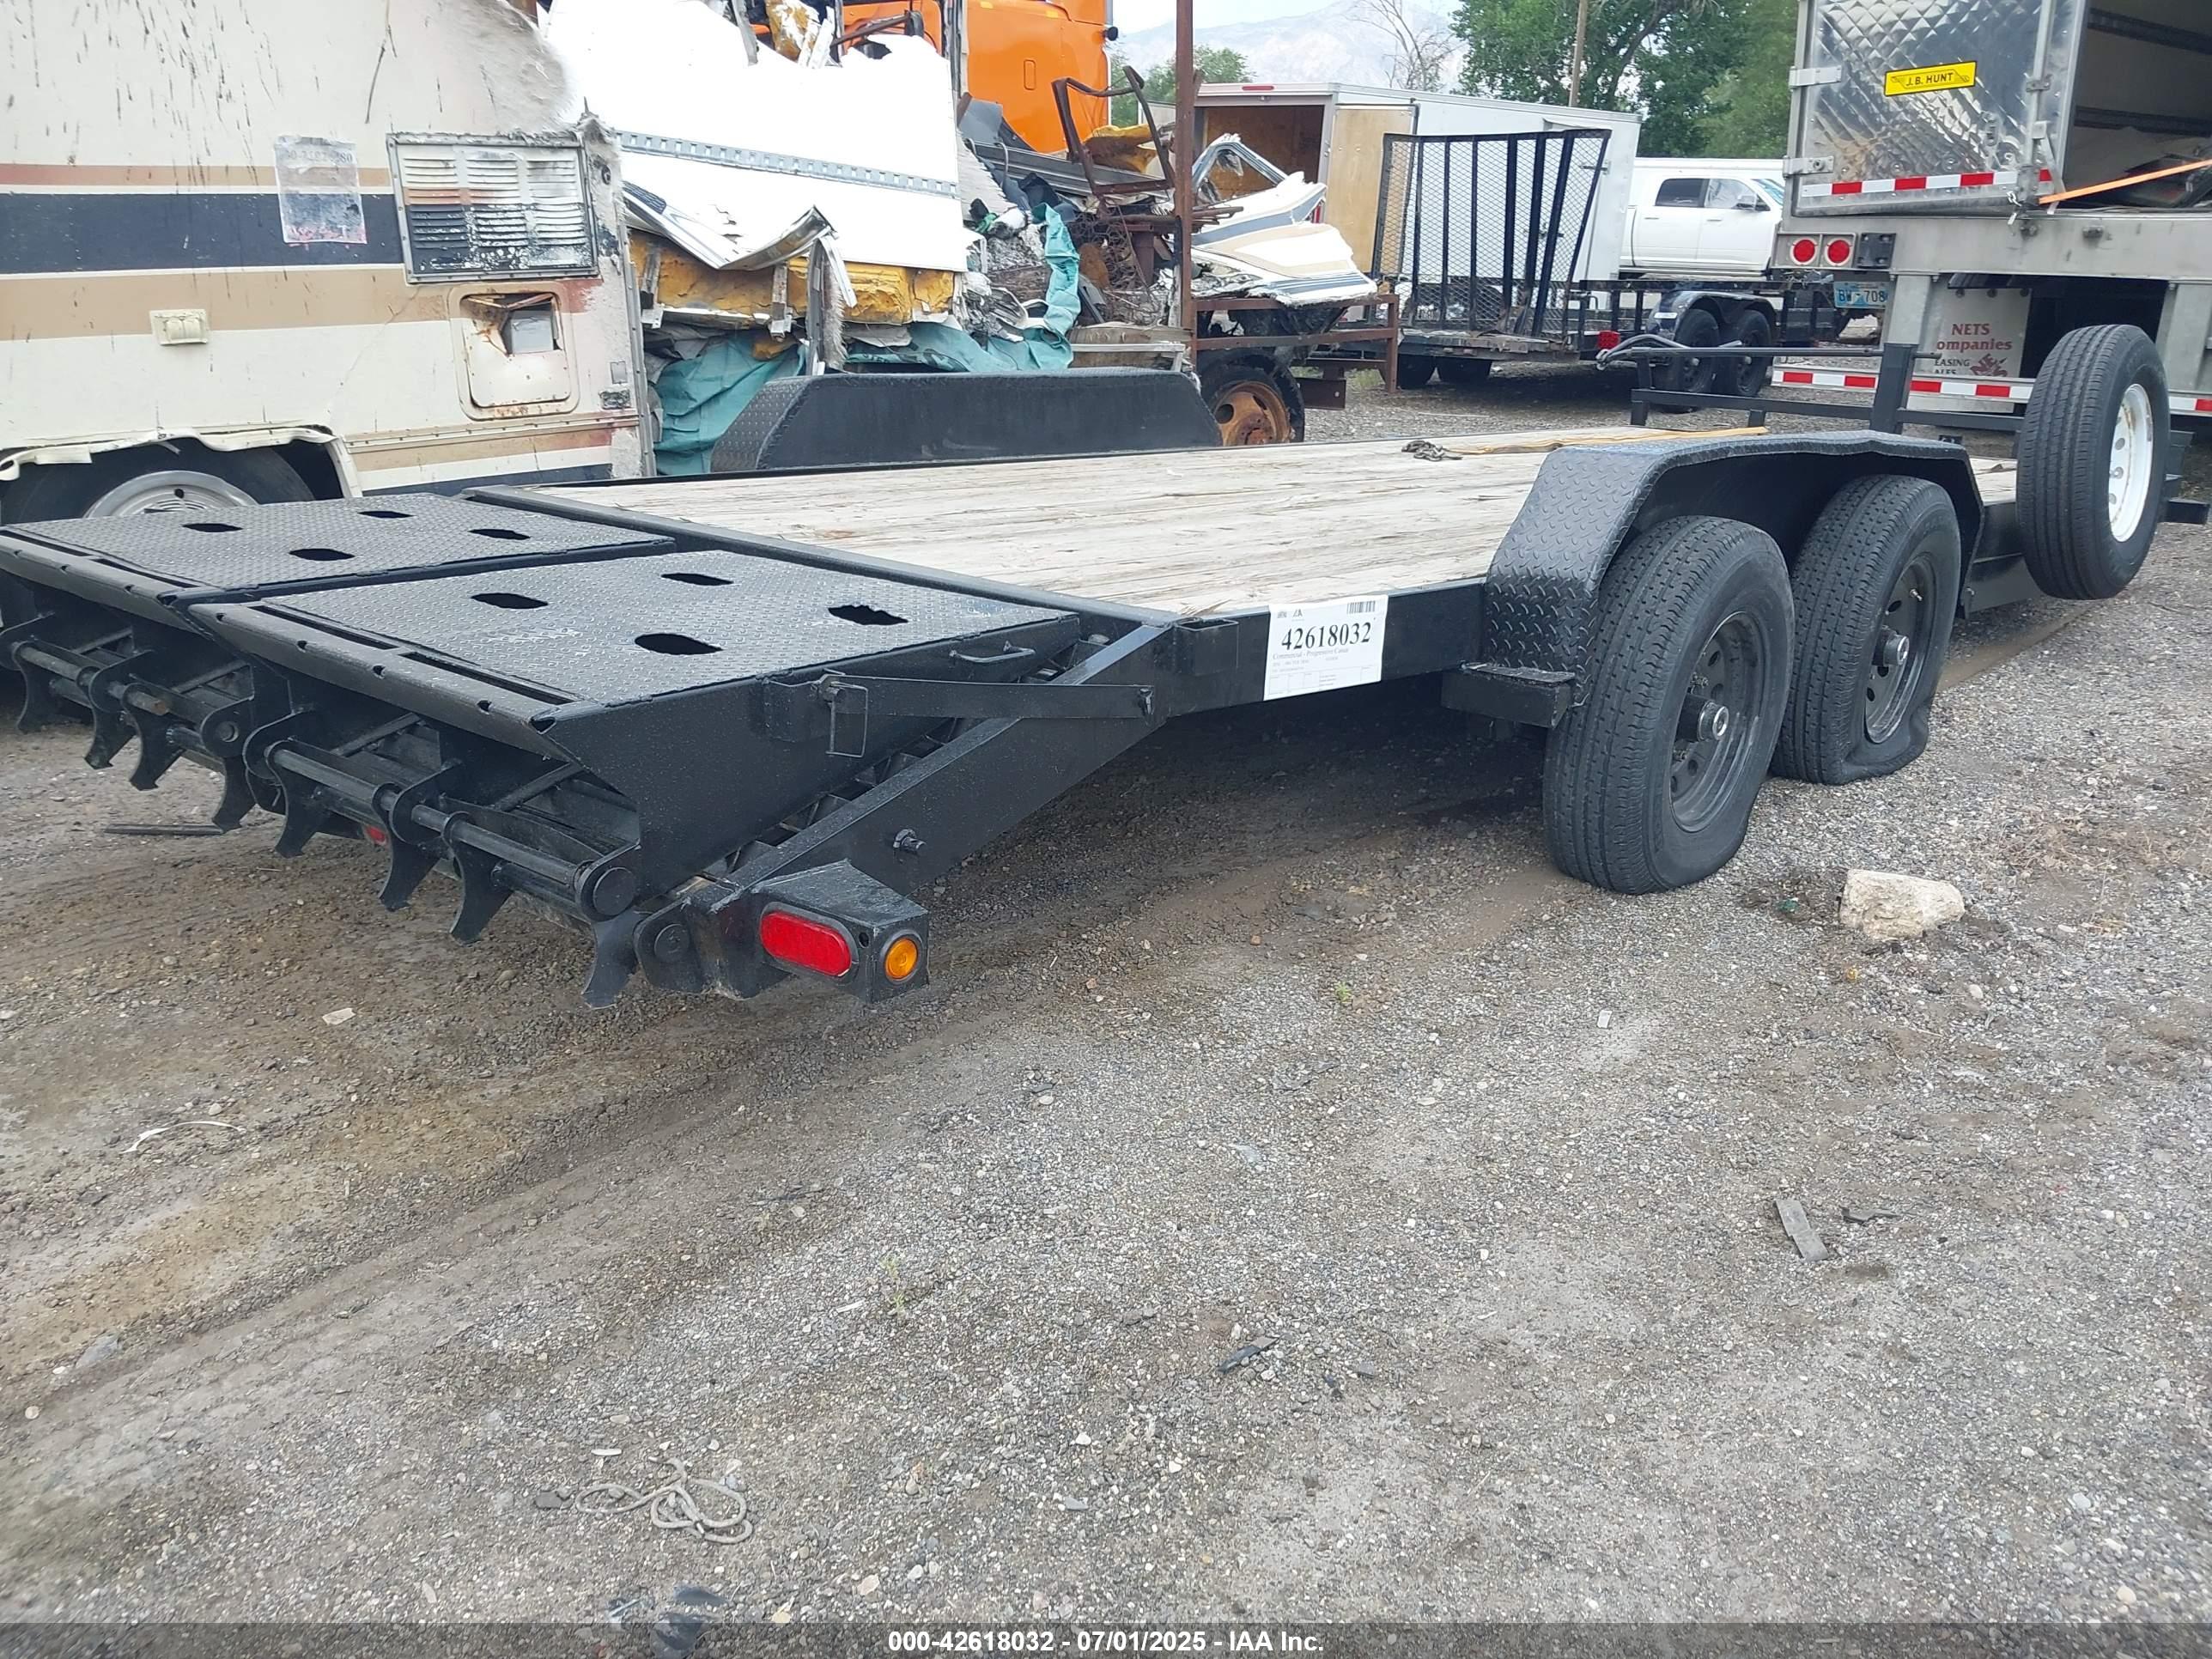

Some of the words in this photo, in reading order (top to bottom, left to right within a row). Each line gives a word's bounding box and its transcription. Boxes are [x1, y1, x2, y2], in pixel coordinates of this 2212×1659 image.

[1926, 72, 1954, 83] HUNT
[1951, 323, 1990, 336] NETS
[1936, 338, 2013, 353] ompanies
[1934, 358, 1971, 367] EASING
[1281, 622, 1371, 650] 42618032
